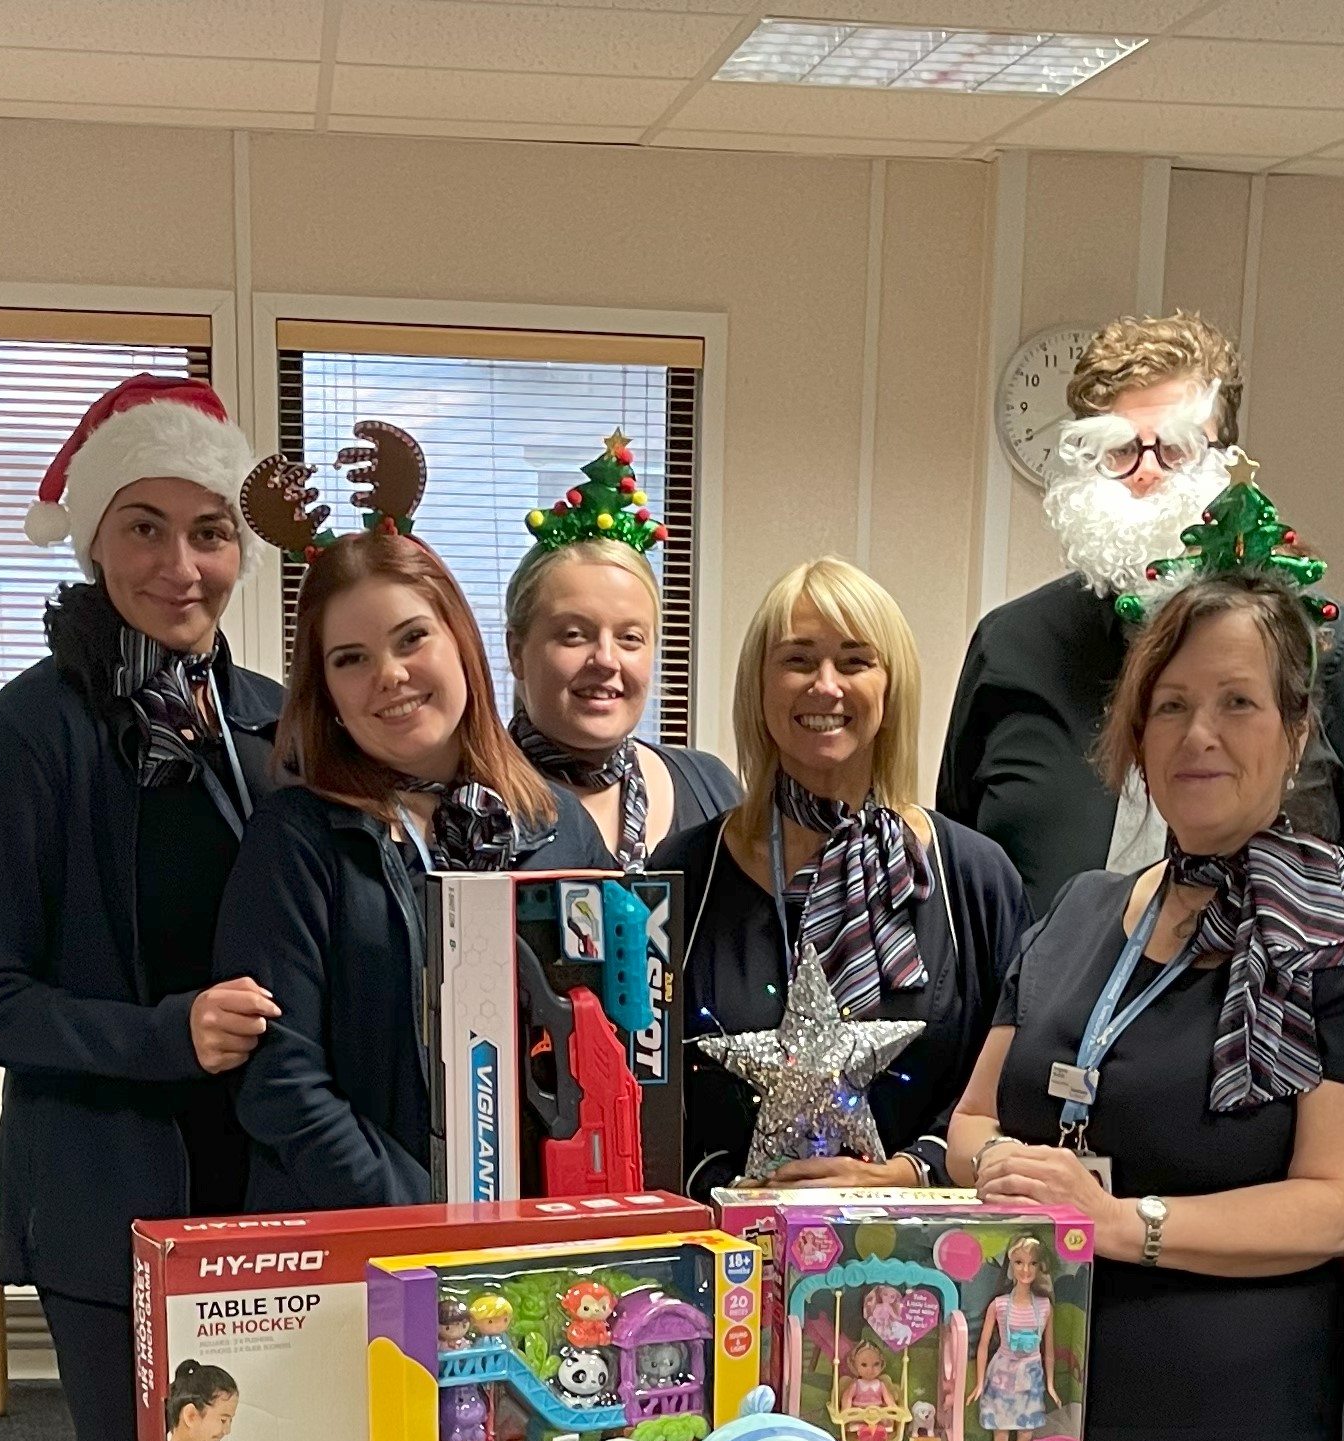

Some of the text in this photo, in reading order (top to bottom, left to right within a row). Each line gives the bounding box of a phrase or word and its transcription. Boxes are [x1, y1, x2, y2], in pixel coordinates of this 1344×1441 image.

[1044, 355, 1058, 368] 11
[1025, 374, 1040, 387] 10
[1019, 401, 1029, 414] 9
[1042, 448, 1051, 461] 7
[200, 1250, 324, 1278] HY-PRO
[196, 1294, 321, 1320] TABLE TOP
[729, 1295, 749, 1308] 20
[197, 1315, 306, 1338] AIR HOCKEY
